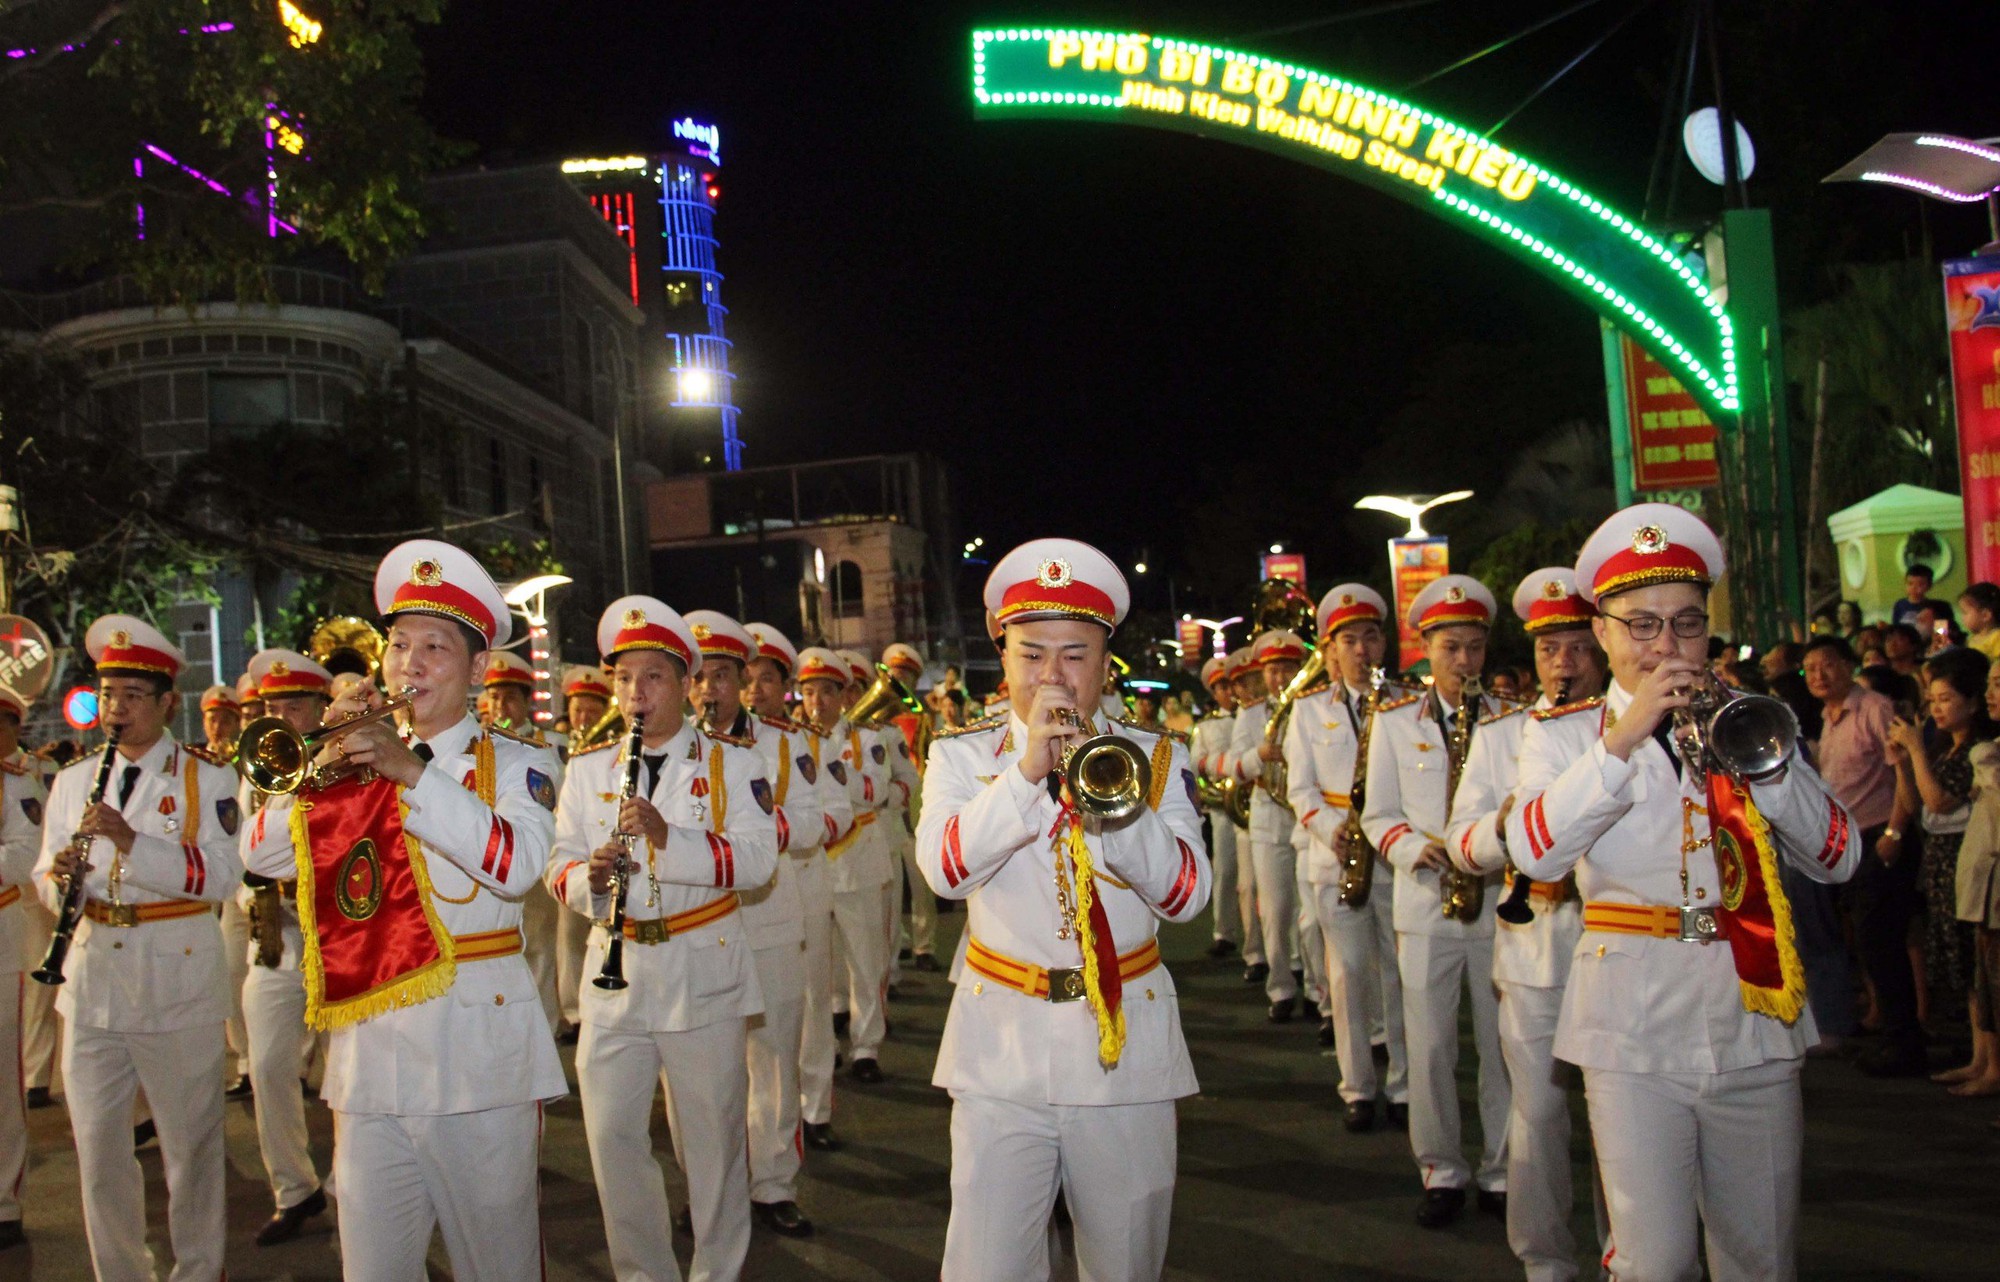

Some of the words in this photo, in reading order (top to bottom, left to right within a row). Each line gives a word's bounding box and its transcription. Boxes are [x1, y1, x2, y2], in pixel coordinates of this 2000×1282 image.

[1122, 80, 1185, 114] Ninh
[1256, 104, 1363, 160] Walking
[1159, 48, 1212, 86] ĐI
[1298, 80, 1421, 148] NINH
